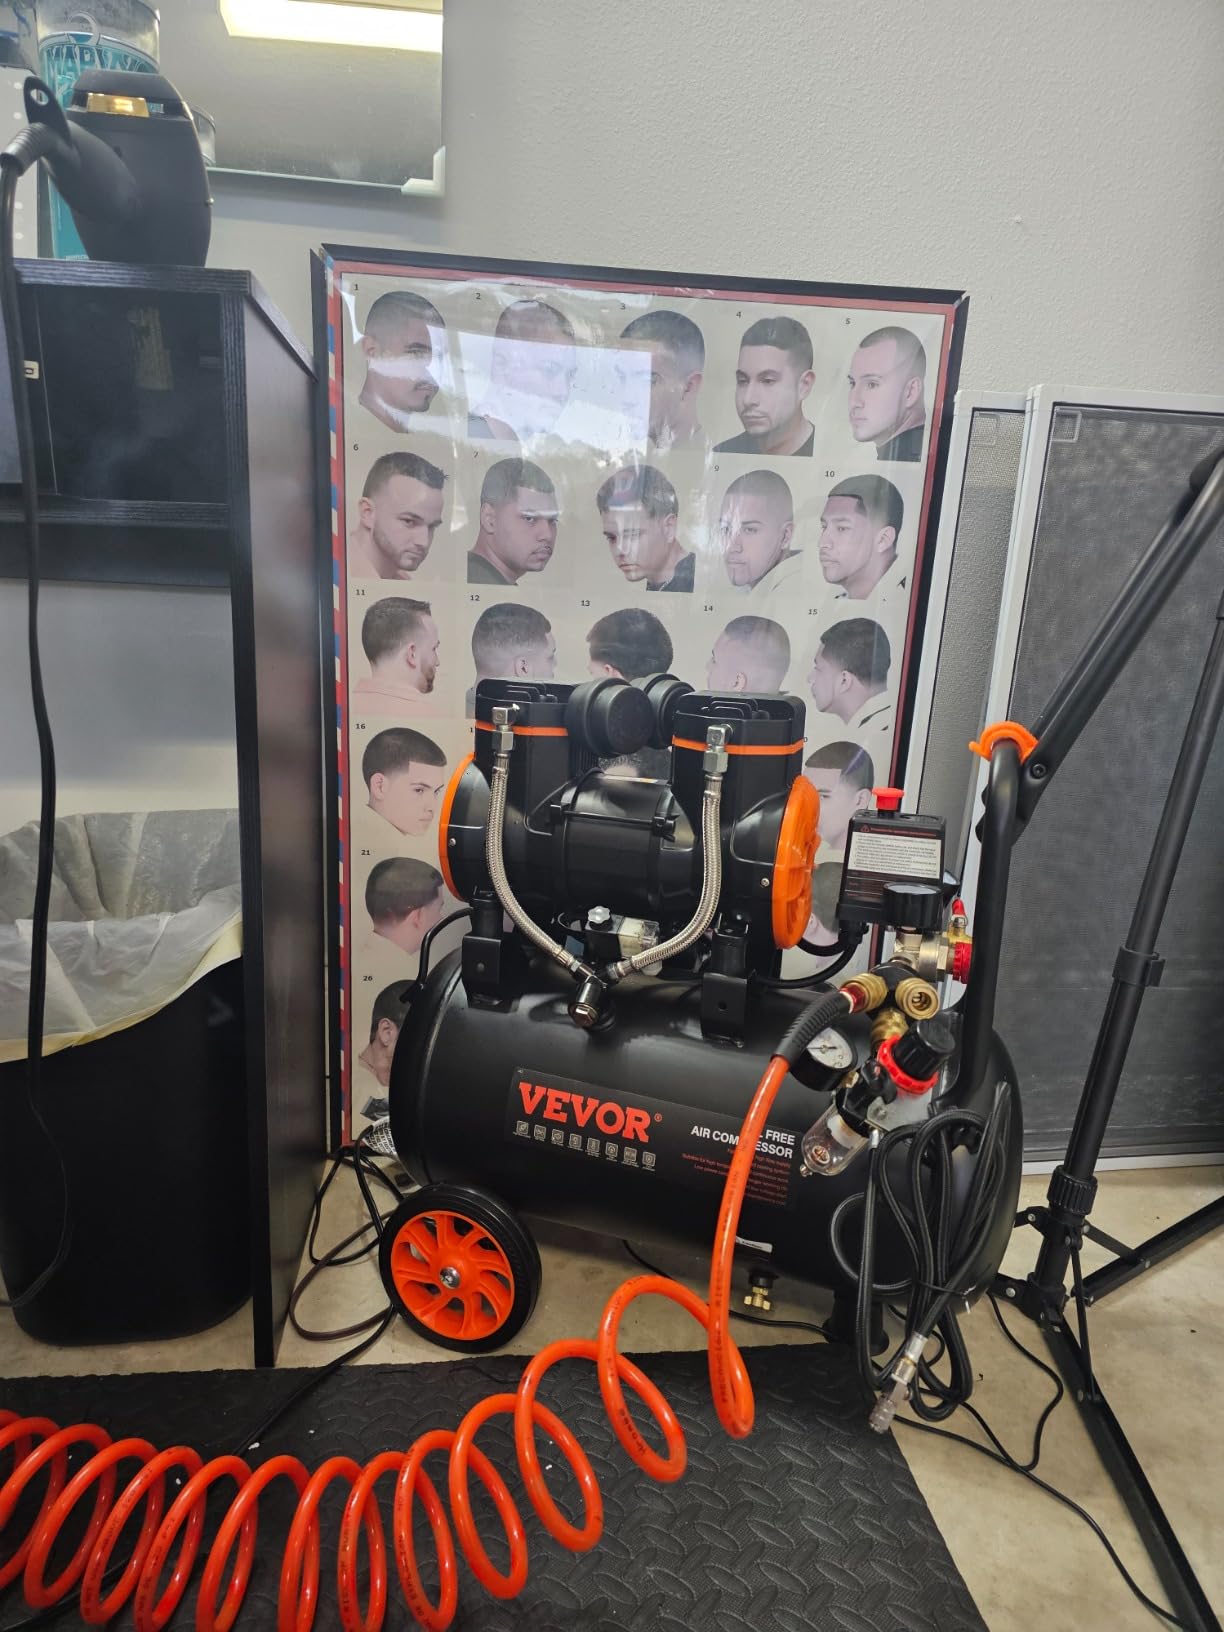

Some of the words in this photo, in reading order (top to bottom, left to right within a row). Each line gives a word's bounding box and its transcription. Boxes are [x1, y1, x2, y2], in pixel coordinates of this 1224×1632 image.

[518, 1082, 651, 1143] VEVOR
[691, 1125, 711, 1139] AIR
[712, 1131, 793, 1159] COMESSOR
[765, 1129, 796, 1146] FREE
